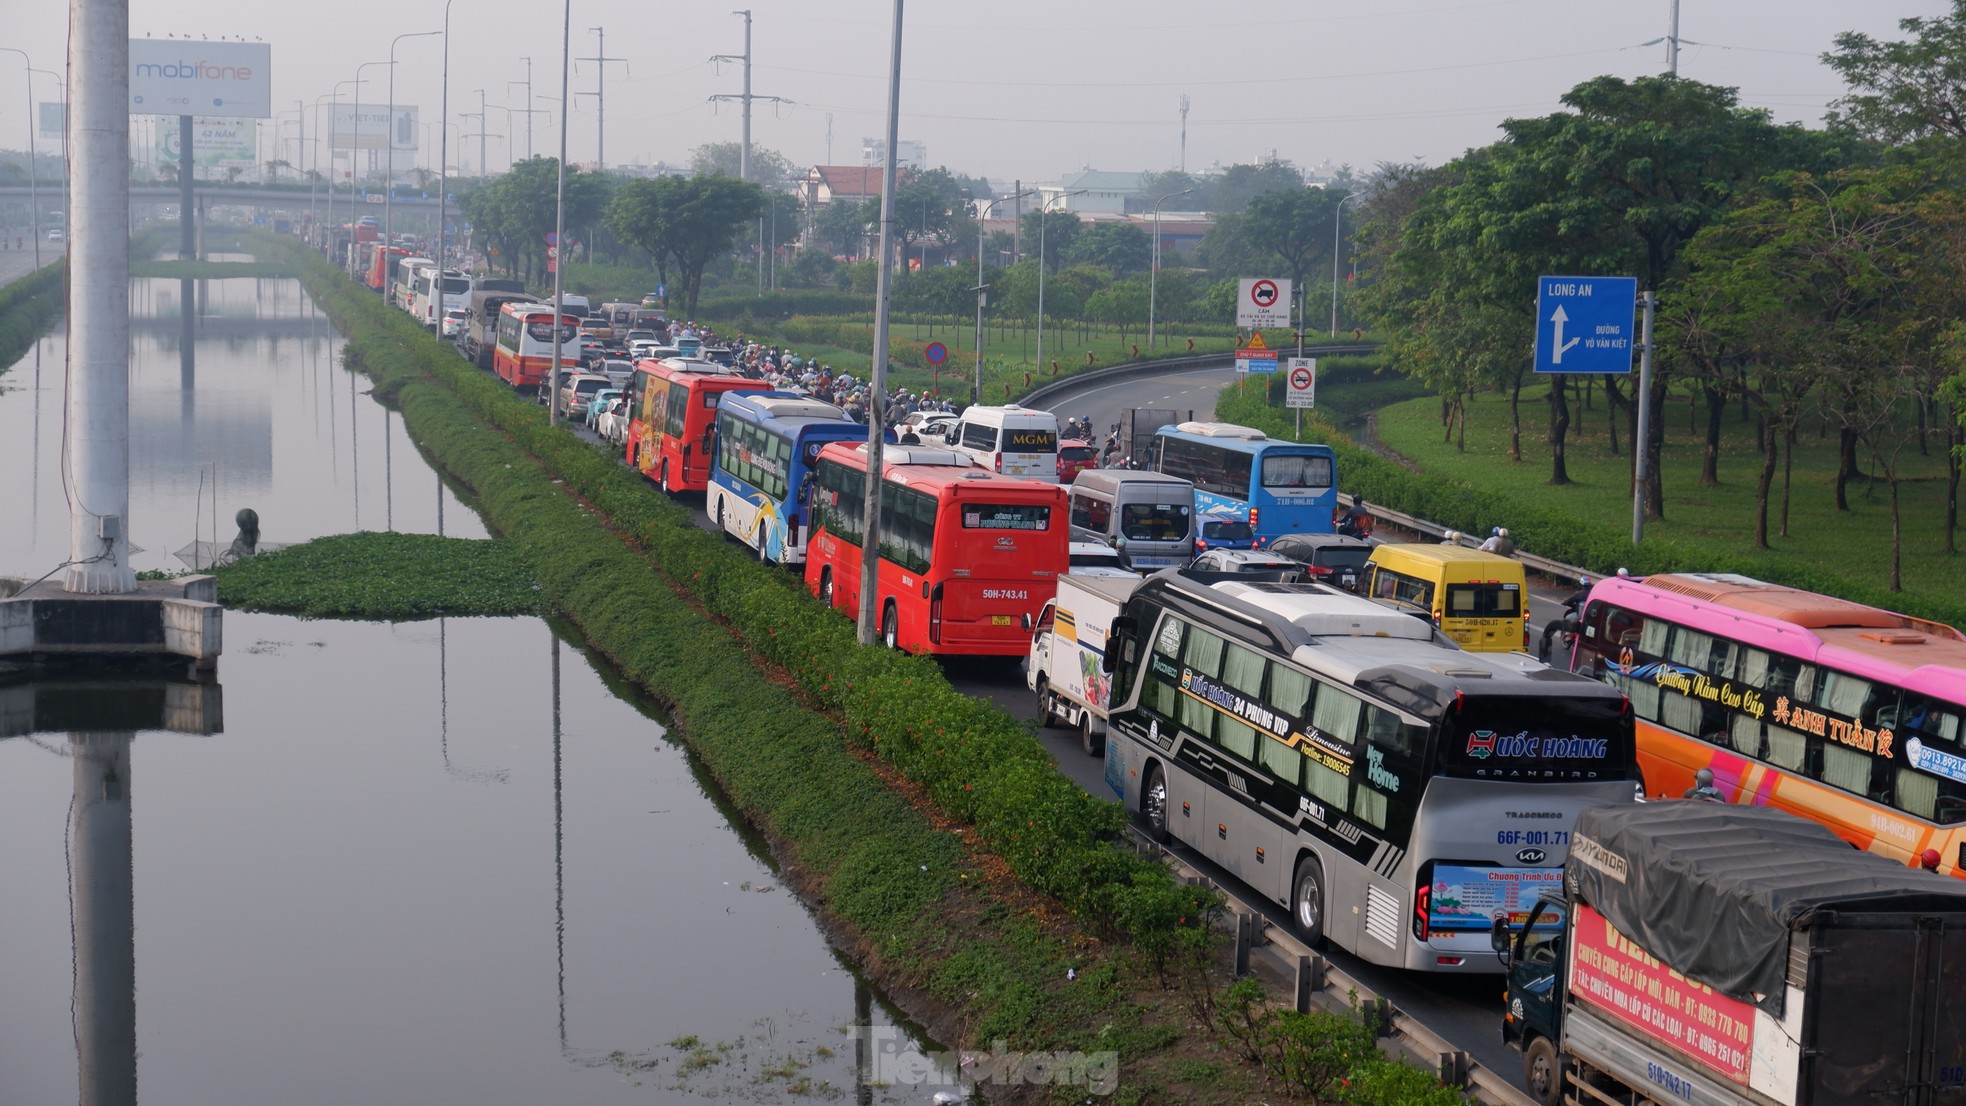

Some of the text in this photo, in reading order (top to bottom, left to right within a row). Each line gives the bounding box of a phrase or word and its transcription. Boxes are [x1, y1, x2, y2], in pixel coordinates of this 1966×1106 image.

[136, 59, 252, 81] mobifone
[1548, 284, 1592, 297] LONG AN
[1596, 323, 1620, 335] ĐƯỜNG
[1596, 337, 1610, 348] VĂN
[1611, 337, 1628, 350] KIỆT
[1012, 434, 1048, 444] MGM
[982, 589, 1028, 600] 50H-743.41
[1234, 697, 1245, 716] 34
[1245, 703, 1273, 730] PHÒNG
[1274, 716, 1290, 737] VIP
[1790, 706, 1827, 737] ANH
[1304, 725, 1352, 757] Limousine
[1542, 735, 1608, 758] HOÀNG
[1300, 742, 1351, 776] Hotline: 19006545
[1366, 744, 1384, 764] New
[1368, 762, 1400, 793] Home
[1476, 770, 1598, 778] GRANBIRD
[1300, 796, 1326, 822] 66F-001.71
[1498, 831, 1568, 845] 66F-001.71
[1520, 852, 1545, 860] KIA
[1578, 942, 1602, 970] CHUYÊN
[1602, 958, 1619, 978] CUNG
[1620, 962, 1634, 986] CẤP
[1634, 969, 1647, 992] LỐP
[1698, 1003, 1716, 1028] 0933
[1719, 1012, 1732, 1037] 778
[1734, 1018, 1749, 1044] 780
[1590, 976, 1613, 1000] CHUYÊN
[1614, 991, 1628, 1010] MUA
[1628, 994, 1641, 1016] LỐP
[1652, 1009, 1666, 1030] CÁC
[1666, 1017, 1682, 1040] LOẠI
[1698, 1032, 1717, 1056] 0965
[1718, 1042, 1731, 1064] 251
[1731, 1050, 1745, 1070] 021
